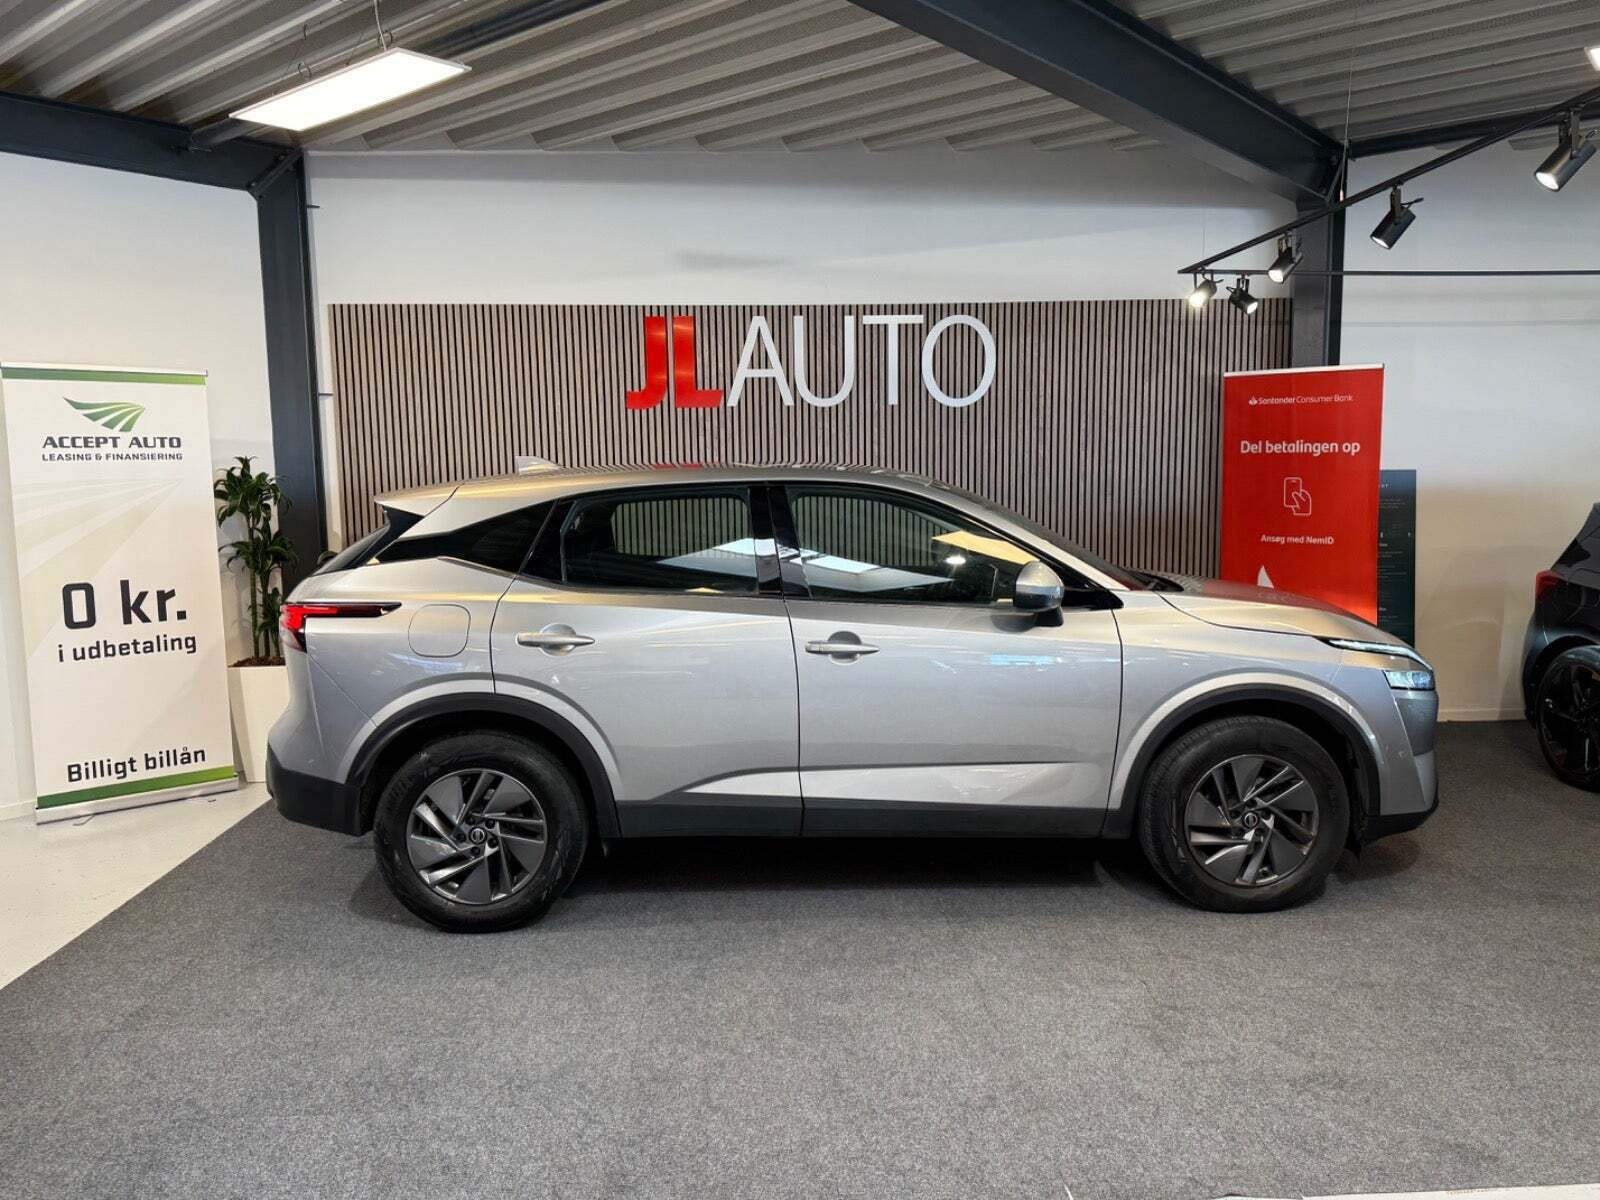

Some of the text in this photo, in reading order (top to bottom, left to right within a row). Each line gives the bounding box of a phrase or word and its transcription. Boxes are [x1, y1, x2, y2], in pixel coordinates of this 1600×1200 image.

[726, 314, 997, 408] AUTO
[1258, 394, 1353, 405] Santander Consumer Bank
[42, 436, 181, 448] ACCEPT AUTO
[1240, 440, 1361, 457] Del betalingen op
[42, 453, 92, 461] LEASING
[105, 453, 183, 461] FINANSIERING
[1260, 534, 1334, 546] Ansøg med NemID
[62, 580, 187, 630] 0 kr.
[58, 634, 197, 662] i udbetaling
[67, 746, 206, 783] Billigt billån
